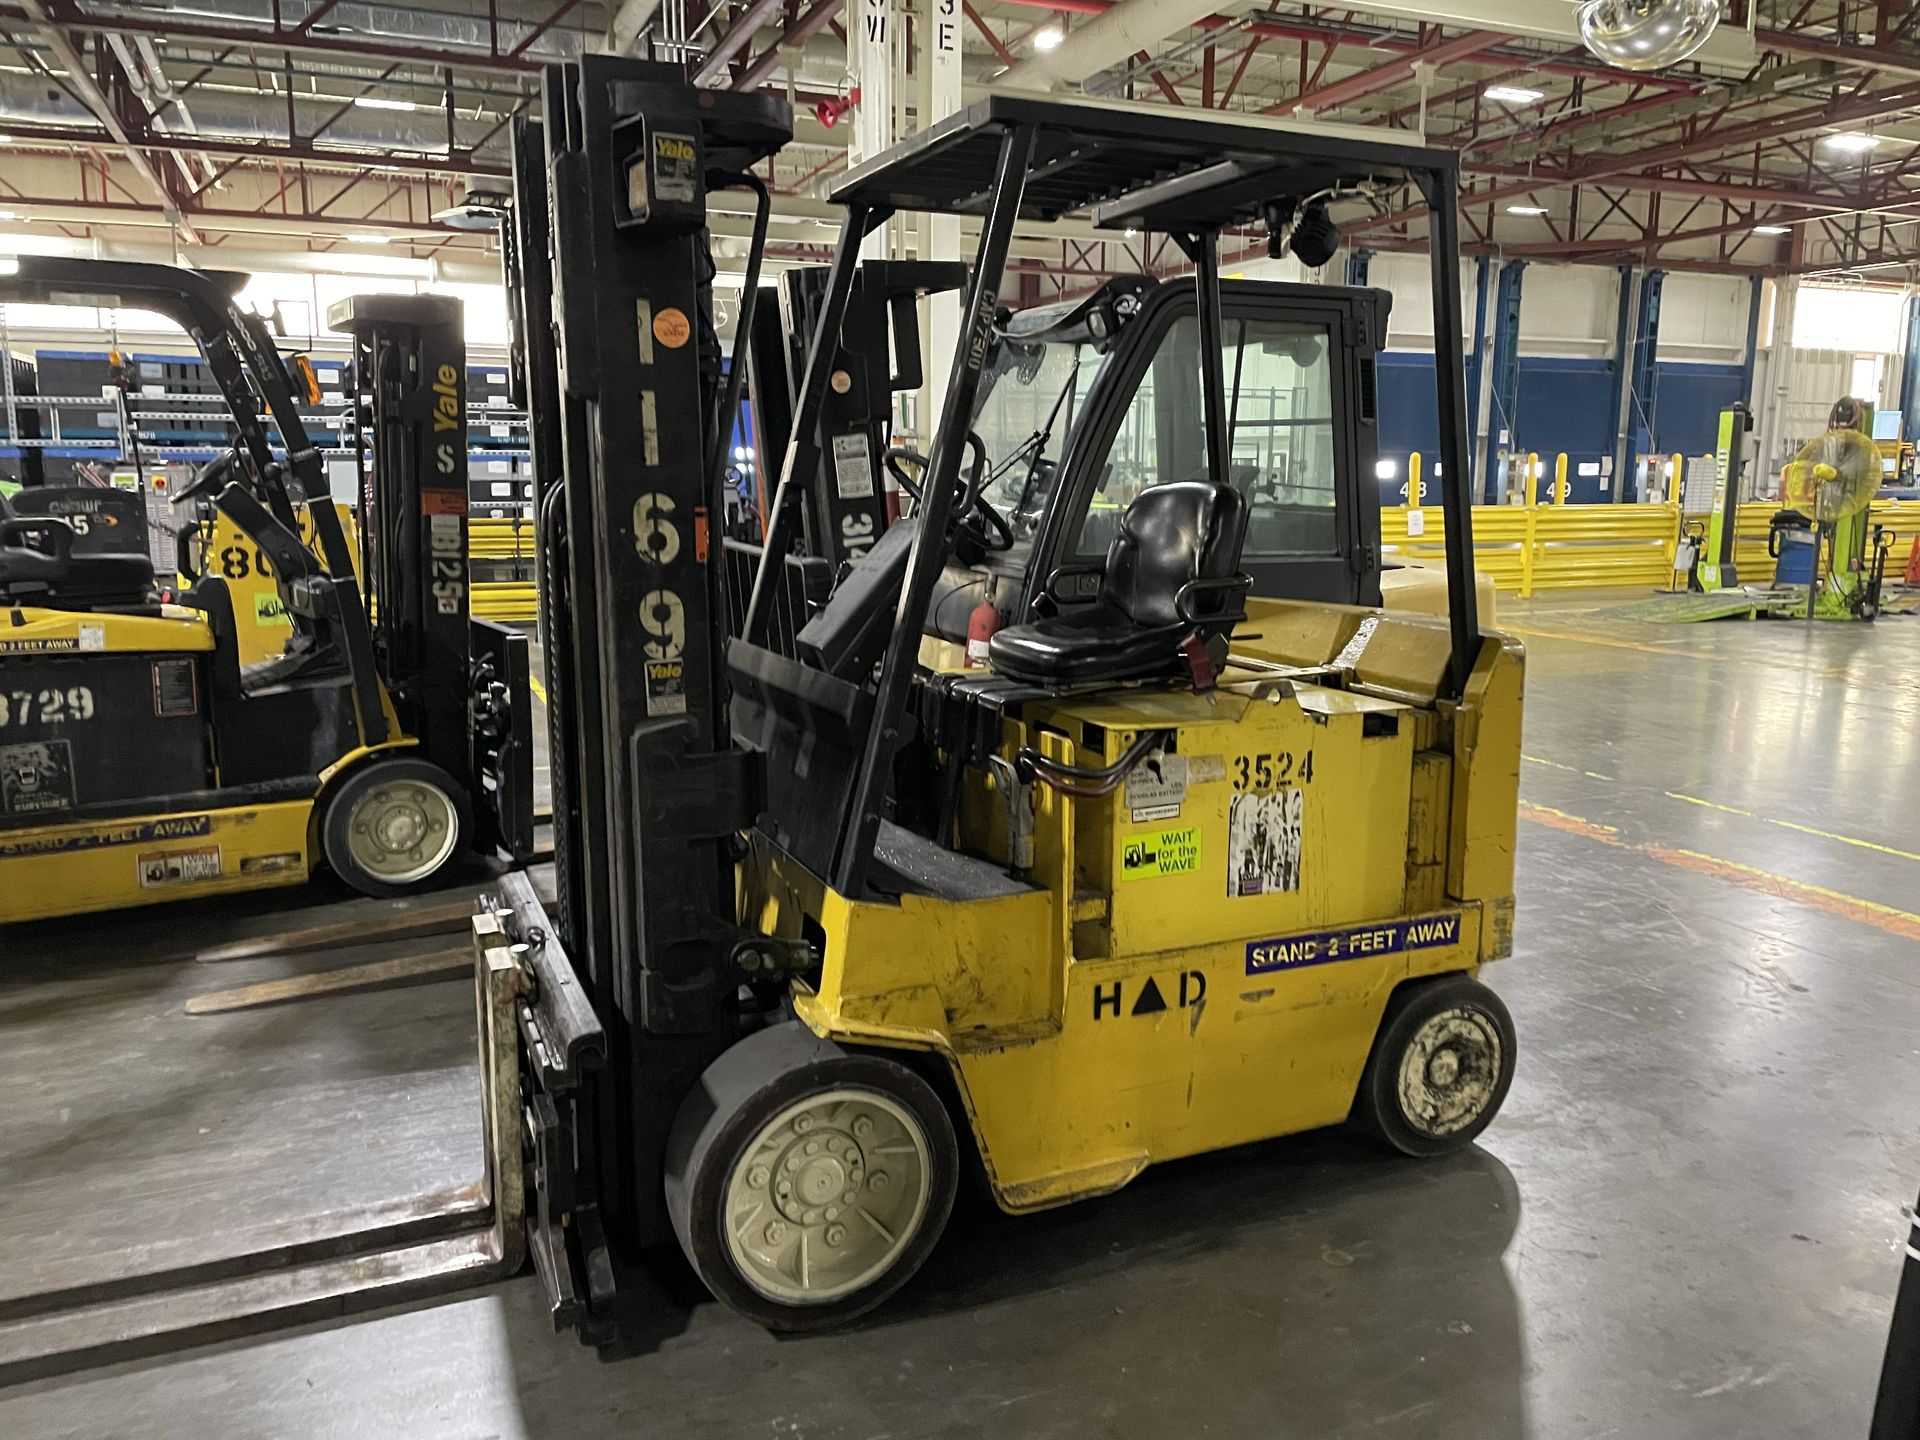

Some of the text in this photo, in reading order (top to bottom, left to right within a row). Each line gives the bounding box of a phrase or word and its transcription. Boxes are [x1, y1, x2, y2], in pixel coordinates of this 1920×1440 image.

[432, 363, 459, 432] Yale
[1399, 480, 1428, 498] 48
[1546, 481, 1572, 498] 49
[1232, 750, 1314, 790] 3524
[153, 817, 207, 838] AWAY
[1160, 830, 1195, 846] WAIT
[1156, 846, 1197, 860] for the
[1158, 859, 1196, 873] WAVE
[1251, 919, 1456, 968] STAND 2 FEET AWAY
